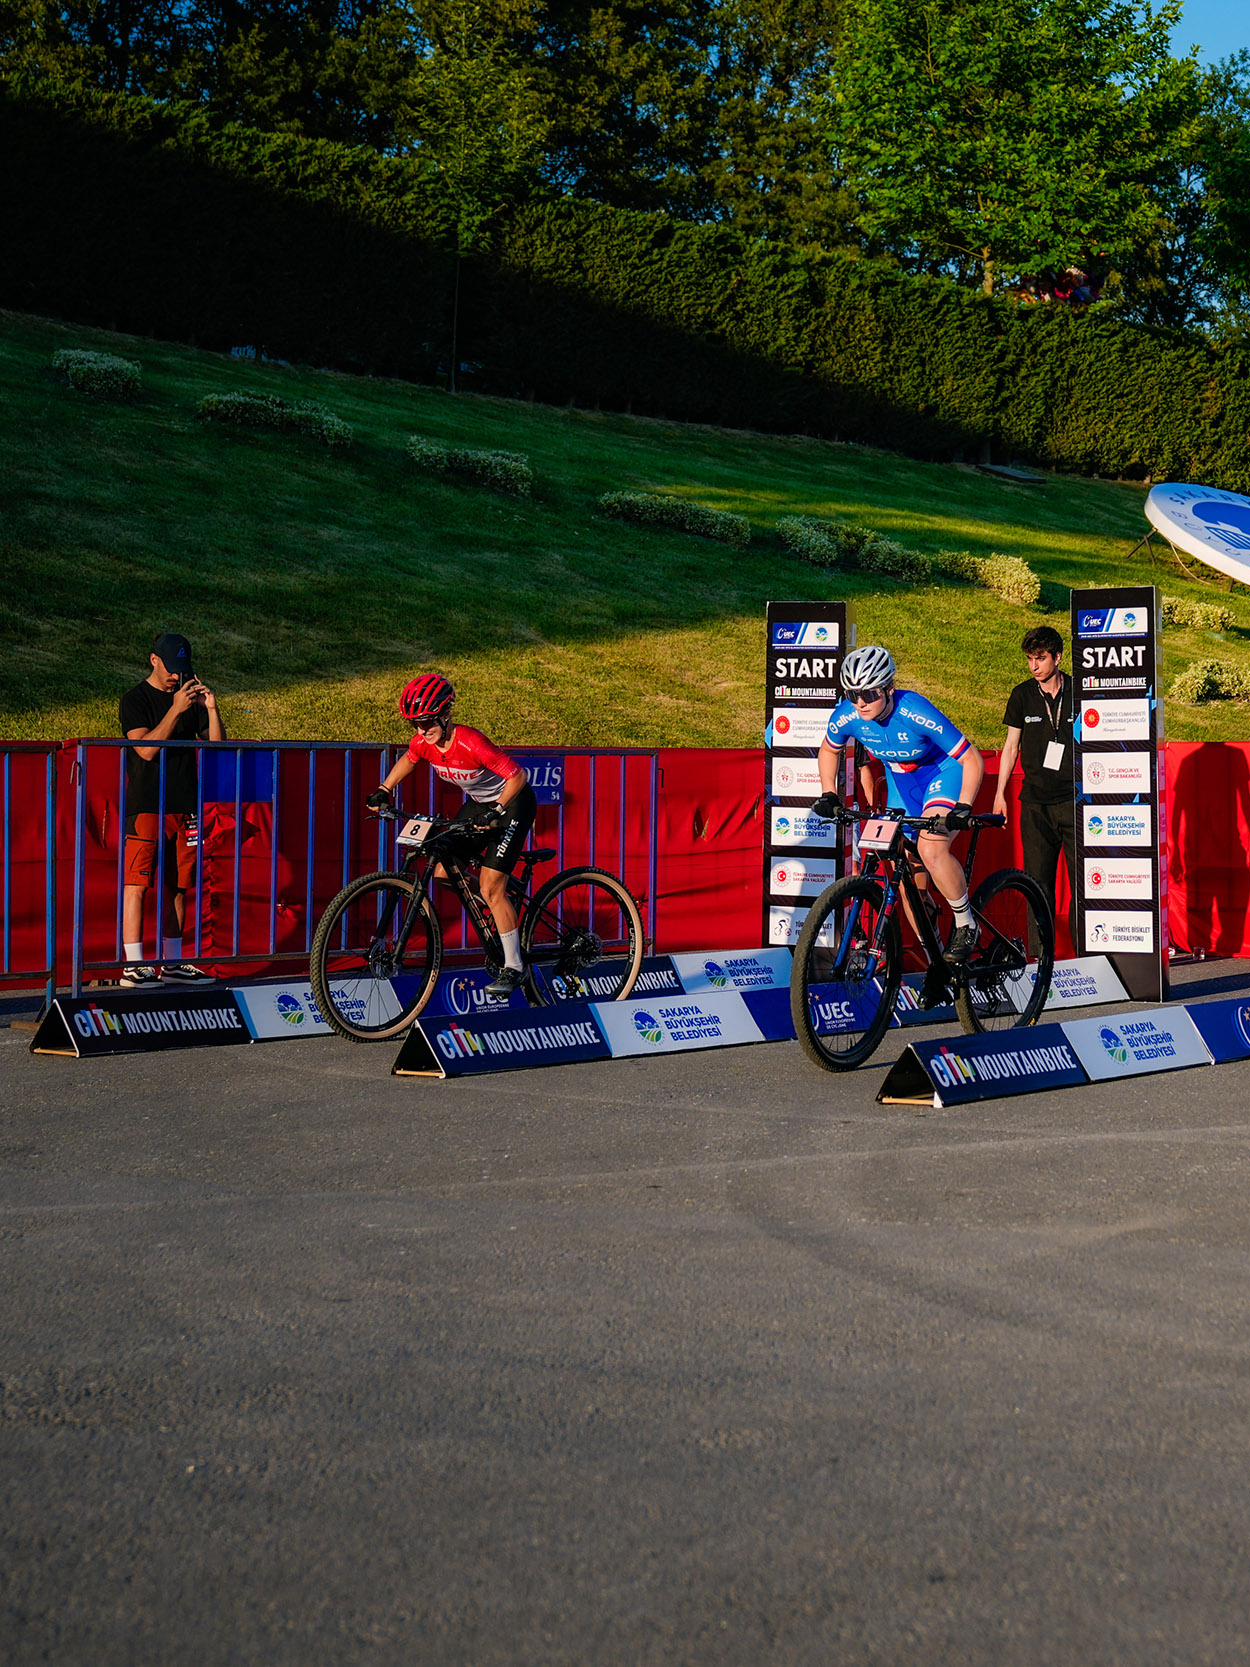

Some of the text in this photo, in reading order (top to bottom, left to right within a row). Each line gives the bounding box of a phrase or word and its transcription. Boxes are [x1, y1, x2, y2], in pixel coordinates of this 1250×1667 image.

[1082, 646, 1146, 668] START
[775, 658, 837, 678] START
[1082, 676, 1146, 688] CITY MOUNTAINBIKE
[775, 685, 836, 696] CITY MOUNTAINBIKE
[551, 791, 560, 800] 54
[410, 824, 421, 836] 8
[875, 825, 883, 838] 1
[496, 818, 519, 858] TÜRKİYE
[724, 958, 759, 968] SAKARYA
[729, 965, 774, 977] BÜYÜKŞEHİR
[733, 974, 774, 987] BELEDİYESİ
[1054, 976, 1096, 988] BÜYÜKŞEHİR
[1059, 987, 1098, 998] BELEDİYESİ
[658, 1006, 703, 1018] SAKARYA
[818, 1001, 854, 1020] UEC
[74, 1006, 242, 1038] CITY MOUNTAINBIKE
[664, 1015, 721, 1030] BÜYÜKŞEHİR
[1119, 1021, 1157, 1035] SAKARYA
[436, 1022, 600, 1059] CITY MOUNTAINBIKE
[670, 1027, 722, 1041] BELEDİYESİ
[1126, 1030, 1174, 1049] BÜYÜKŞEHİR
[1133, 1045, 1176, 1061] BELEDİYESİ
[930, 1045, 1077, 1088] CITY MOUNTAINBIKE
